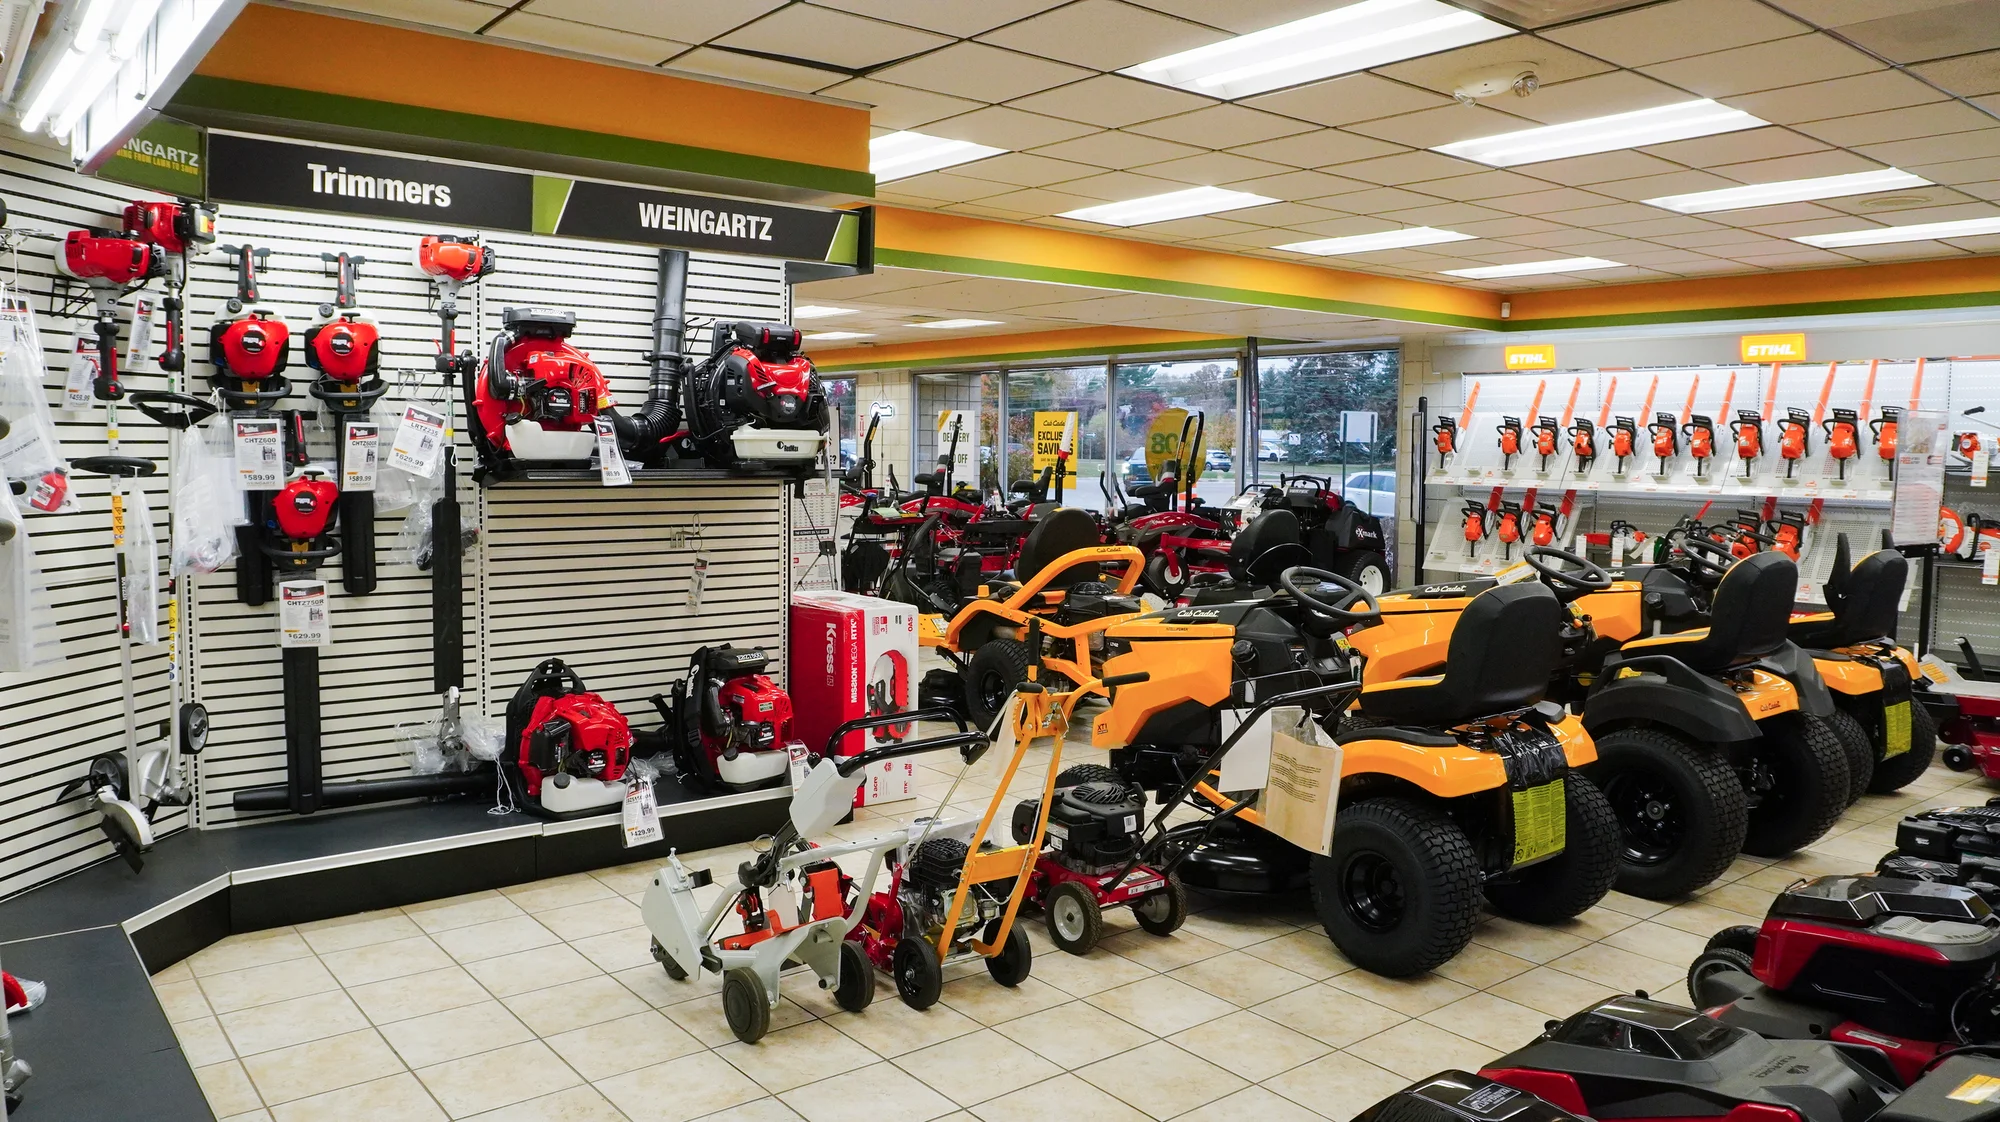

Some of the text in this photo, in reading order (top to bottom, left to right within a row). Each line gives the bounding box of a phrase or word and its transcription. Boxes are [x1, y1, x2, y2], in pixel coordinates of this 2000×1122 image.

[122, 138, 199, 167] NGARTZ
[307, 163, 451, 208] Trimmers
[638, 202, 773, 242] WEINGARTZ
[1748, 344, 1797, 357] STIHL
[1509, 353, 1547, 364] STIHL
[1053, 419, 1066, 427] Cade
[943, 433, 970, 442] DELERY
[395, 452, 424, 467] $629.99
[957, 454, 968, 463] OFF
[1177, 609, 1220, 617] Cub Cadet
[826, 622, 837, 674] Kress
[850, 642, 858, 665] MEGA
[1097, 723, 1108, 731] XT1
